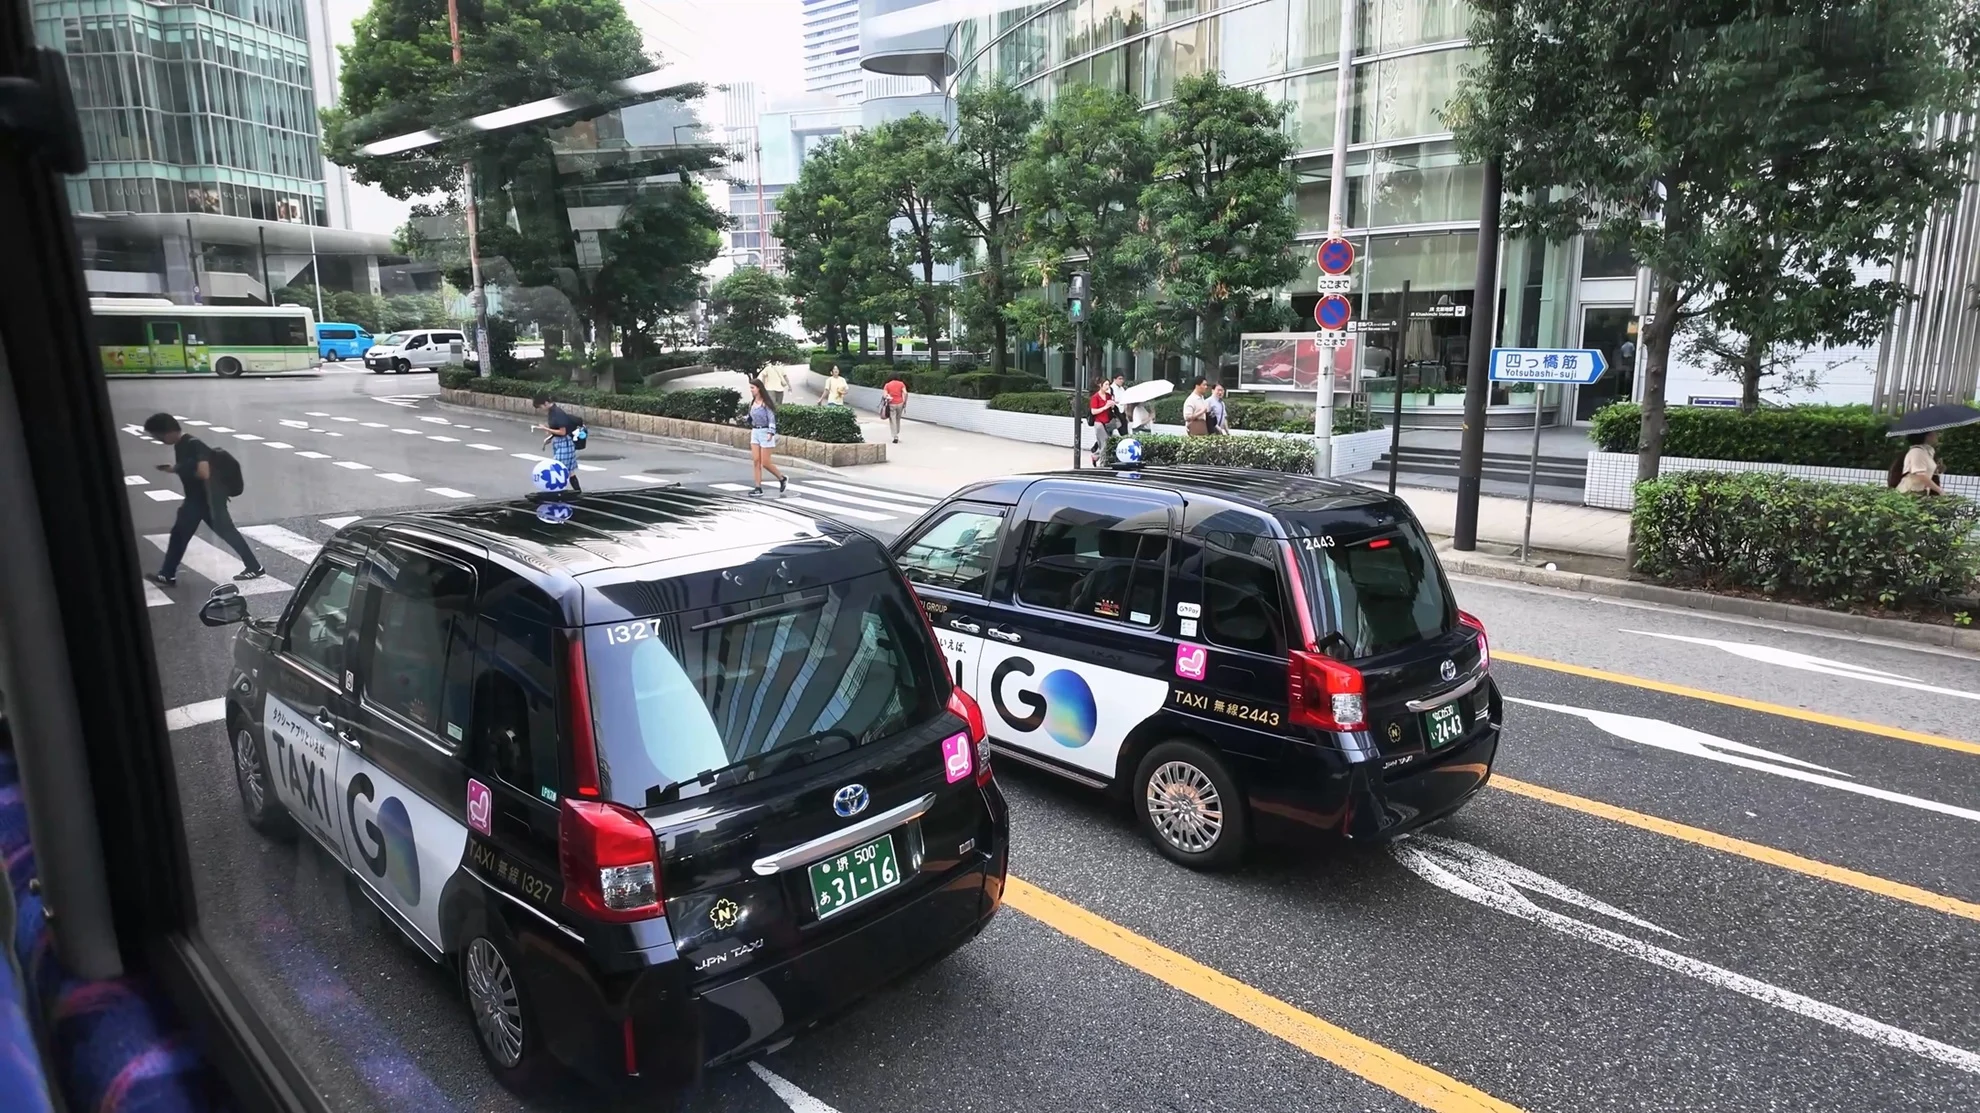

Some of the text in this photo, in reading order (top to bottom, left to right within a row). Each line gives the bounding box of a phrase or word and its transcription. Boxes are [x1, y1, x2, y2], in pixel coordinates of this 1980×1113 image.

[1319, 280, 1349, 289] ここまで
[1505, 368, 1577, 380] Yotsubashi-suji
[550, 470, 566, 485] N
[1302, 535, 1336, 551] 2443
[926, 601, 948, 614] GROUP
[606, 618, 661, 645] 1327
[1174, 689, 1208, 710] TAXI
[272, 729, 332, 829] TAXI
[854, 844, 877, 866] 500
[469, 836, 496, 872] TAXI
[521, 874, 554, 904] 1327
[820, 855, 894, 907] あ 31-16
[718, 907, 731, 922] N
